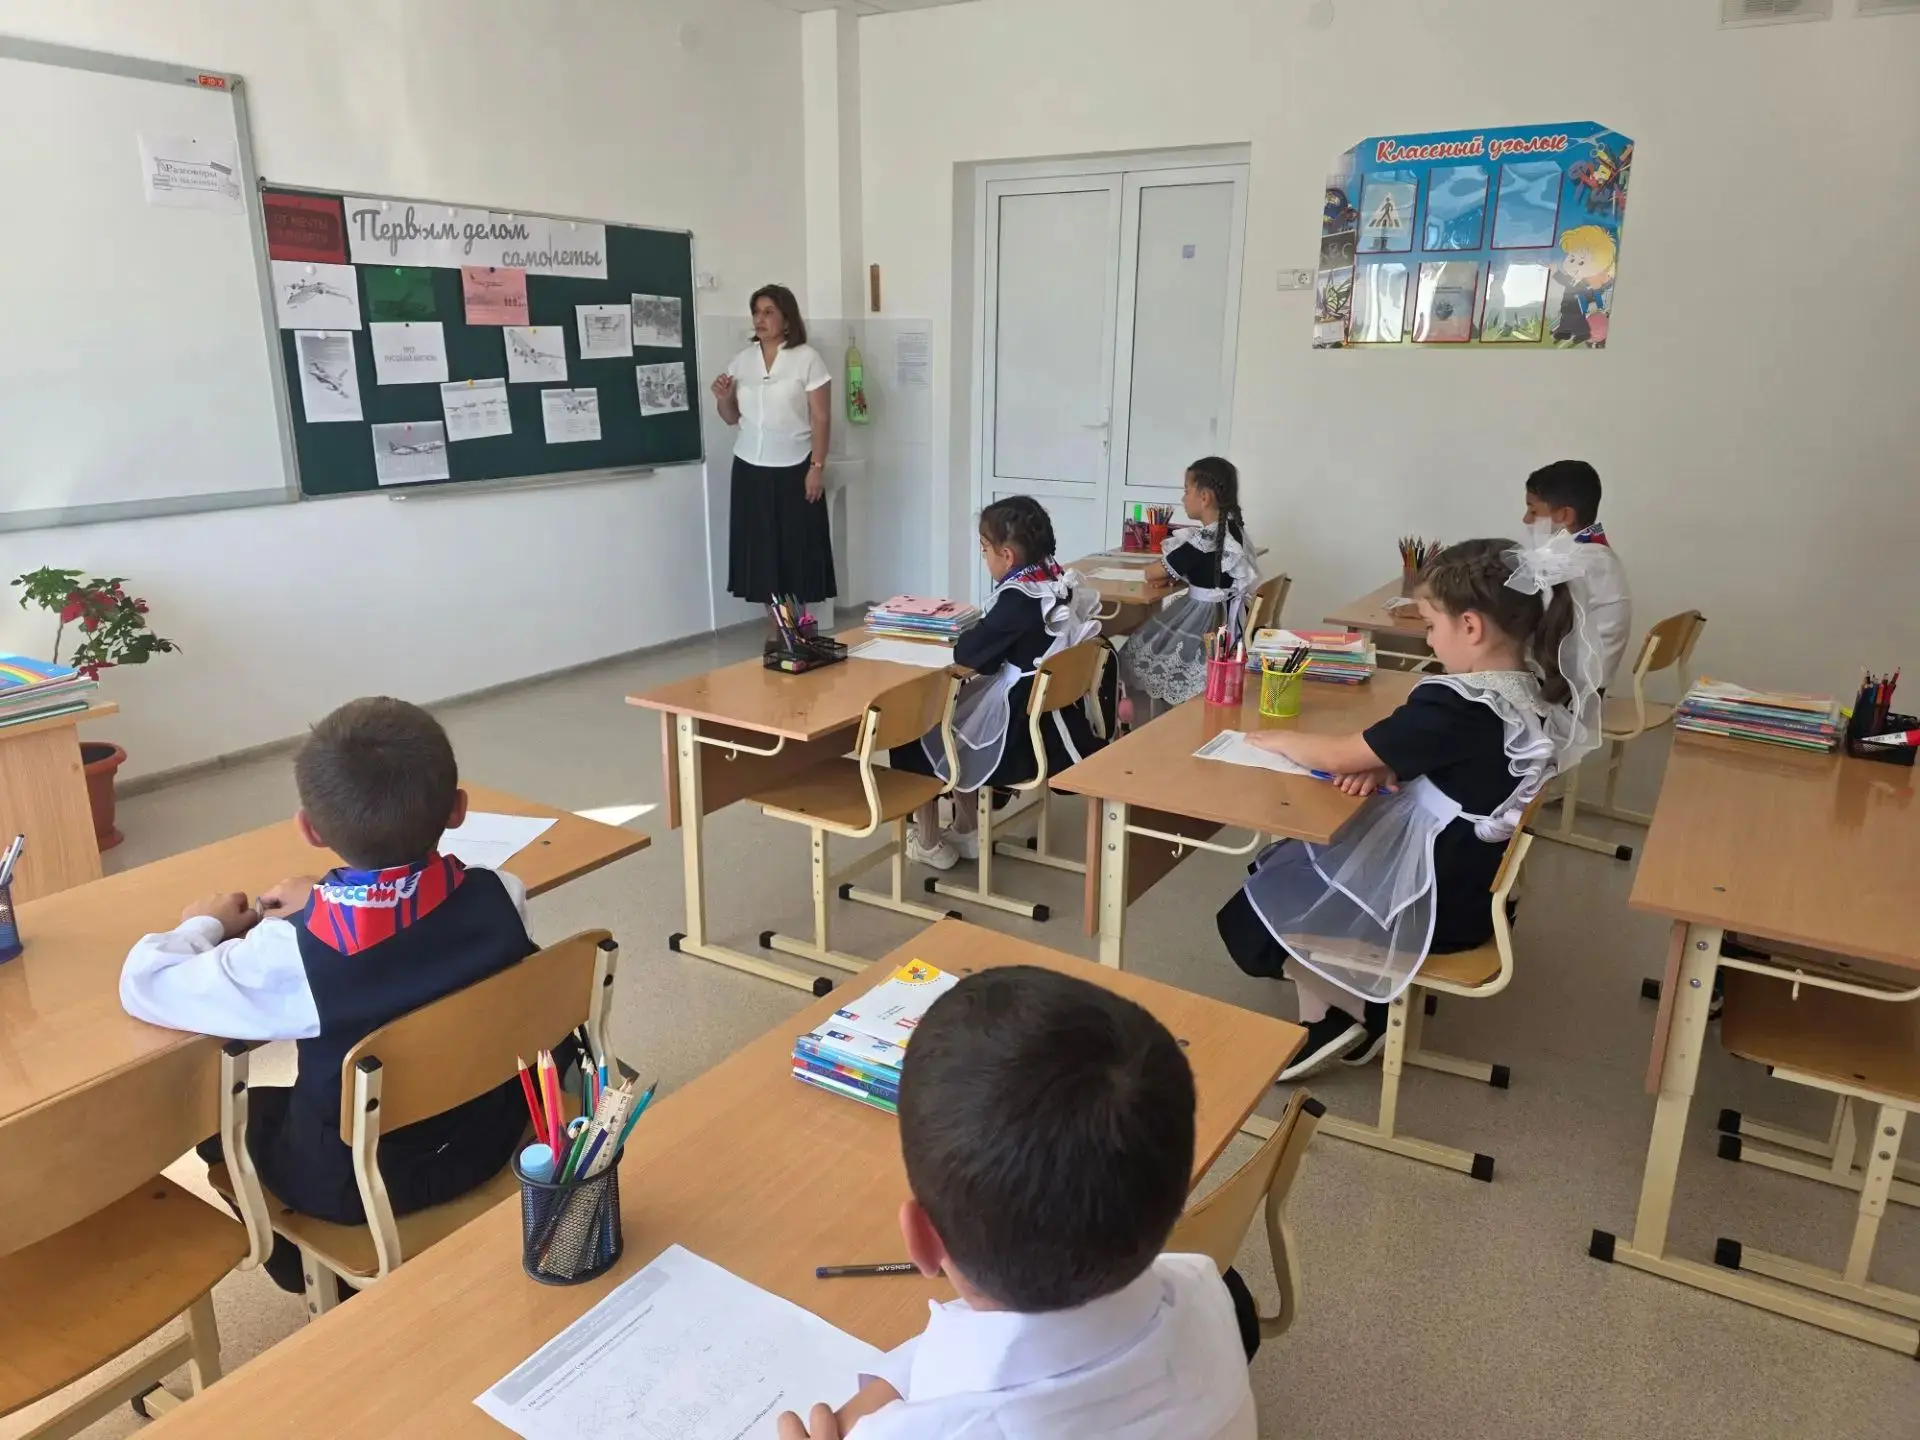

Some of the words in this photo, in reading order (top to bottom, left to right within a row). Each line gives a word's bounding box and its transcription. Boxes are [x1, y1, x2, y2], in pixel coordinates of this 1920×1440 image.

[1488, 134, 1568, 161] уголок
[352, 206, 460, 256] Первым
[463, 222, 530, 256] делом
[502, 249, 602, 268] самолеты
